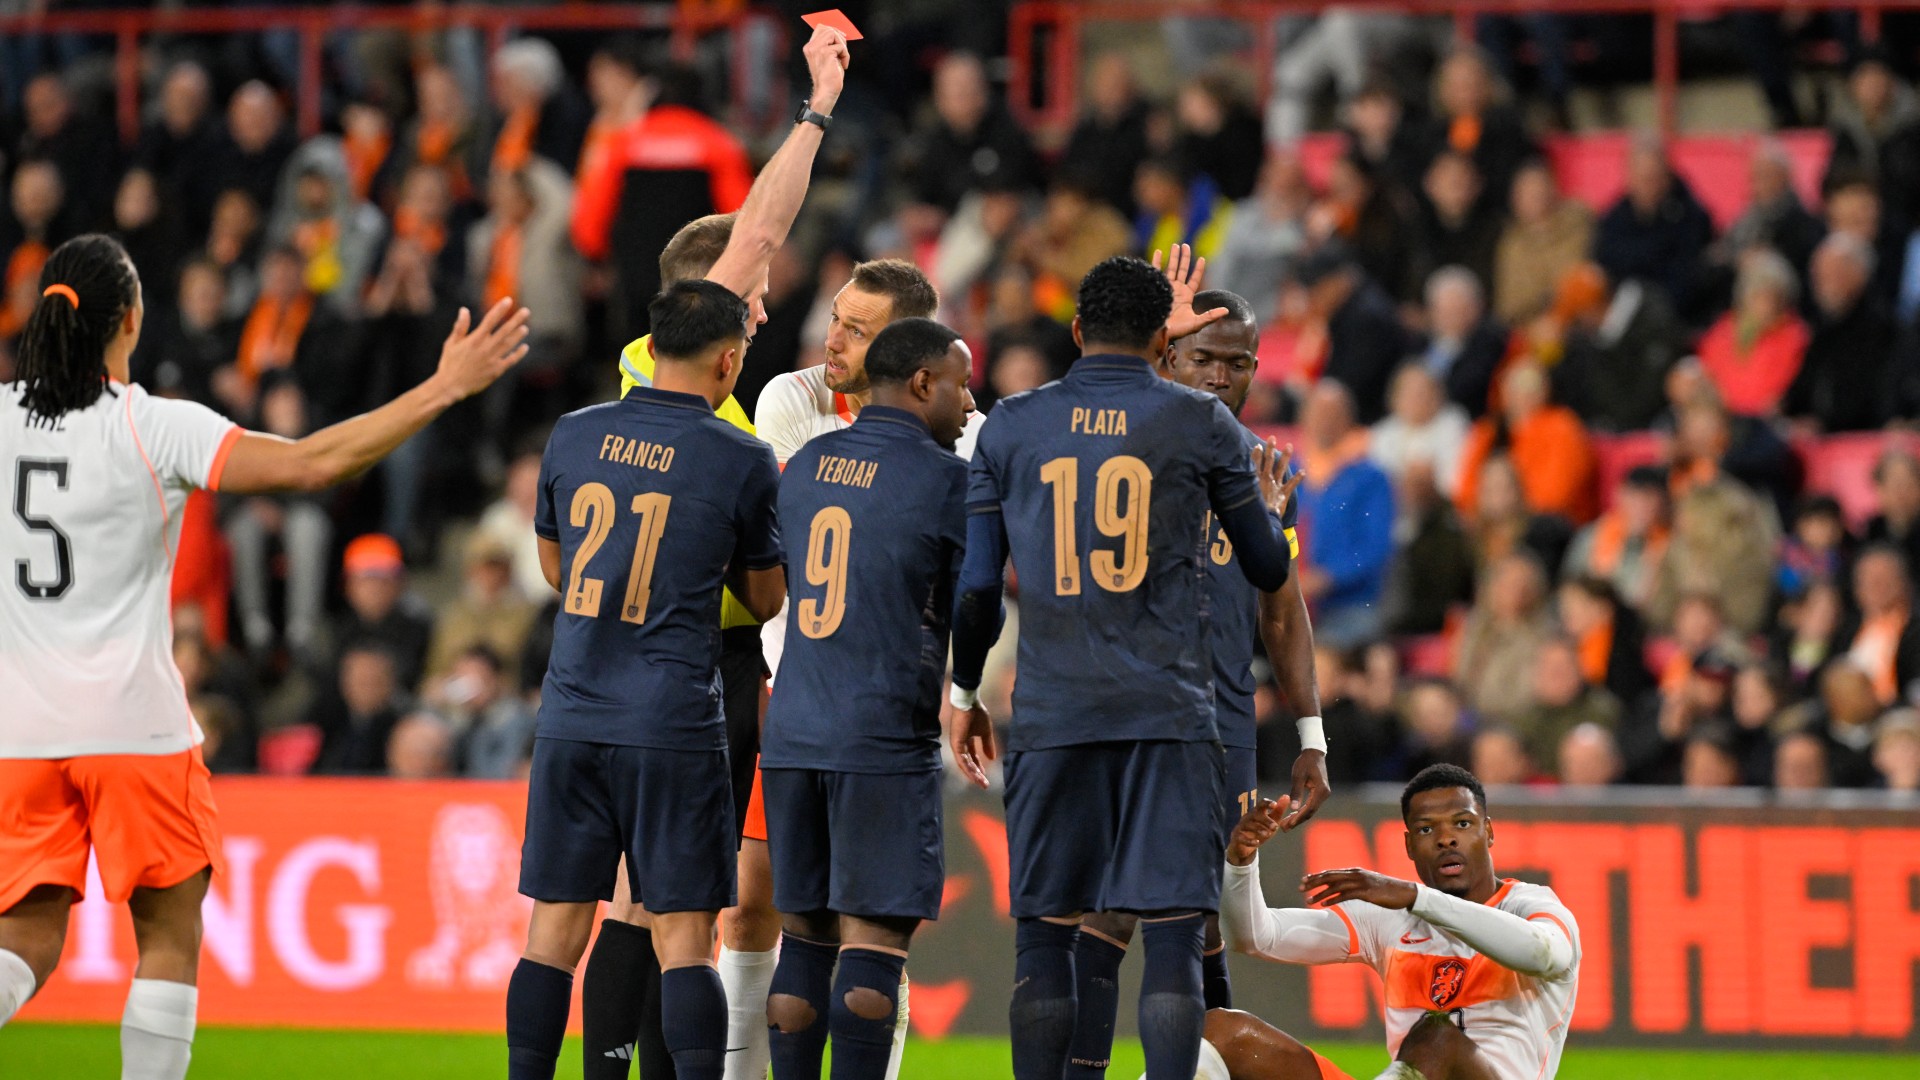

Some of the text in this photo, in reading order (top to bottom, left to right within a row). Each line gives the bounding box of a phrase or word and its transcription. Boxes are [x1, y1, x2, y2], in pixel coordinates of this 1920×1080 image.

[599, 434, 675, 473] FRANCO
[815, 454, 879, 489] YEBOAH
[1071, 407, 1127, 436] PLATA
[13, 455, 75, 603] 5
[564, 481, 672, 625] 21
[798, 505, 852, 640] 9
[1040, 455, 1153, 596] 19
[1304, 819, 1920, 1038] NTHER
